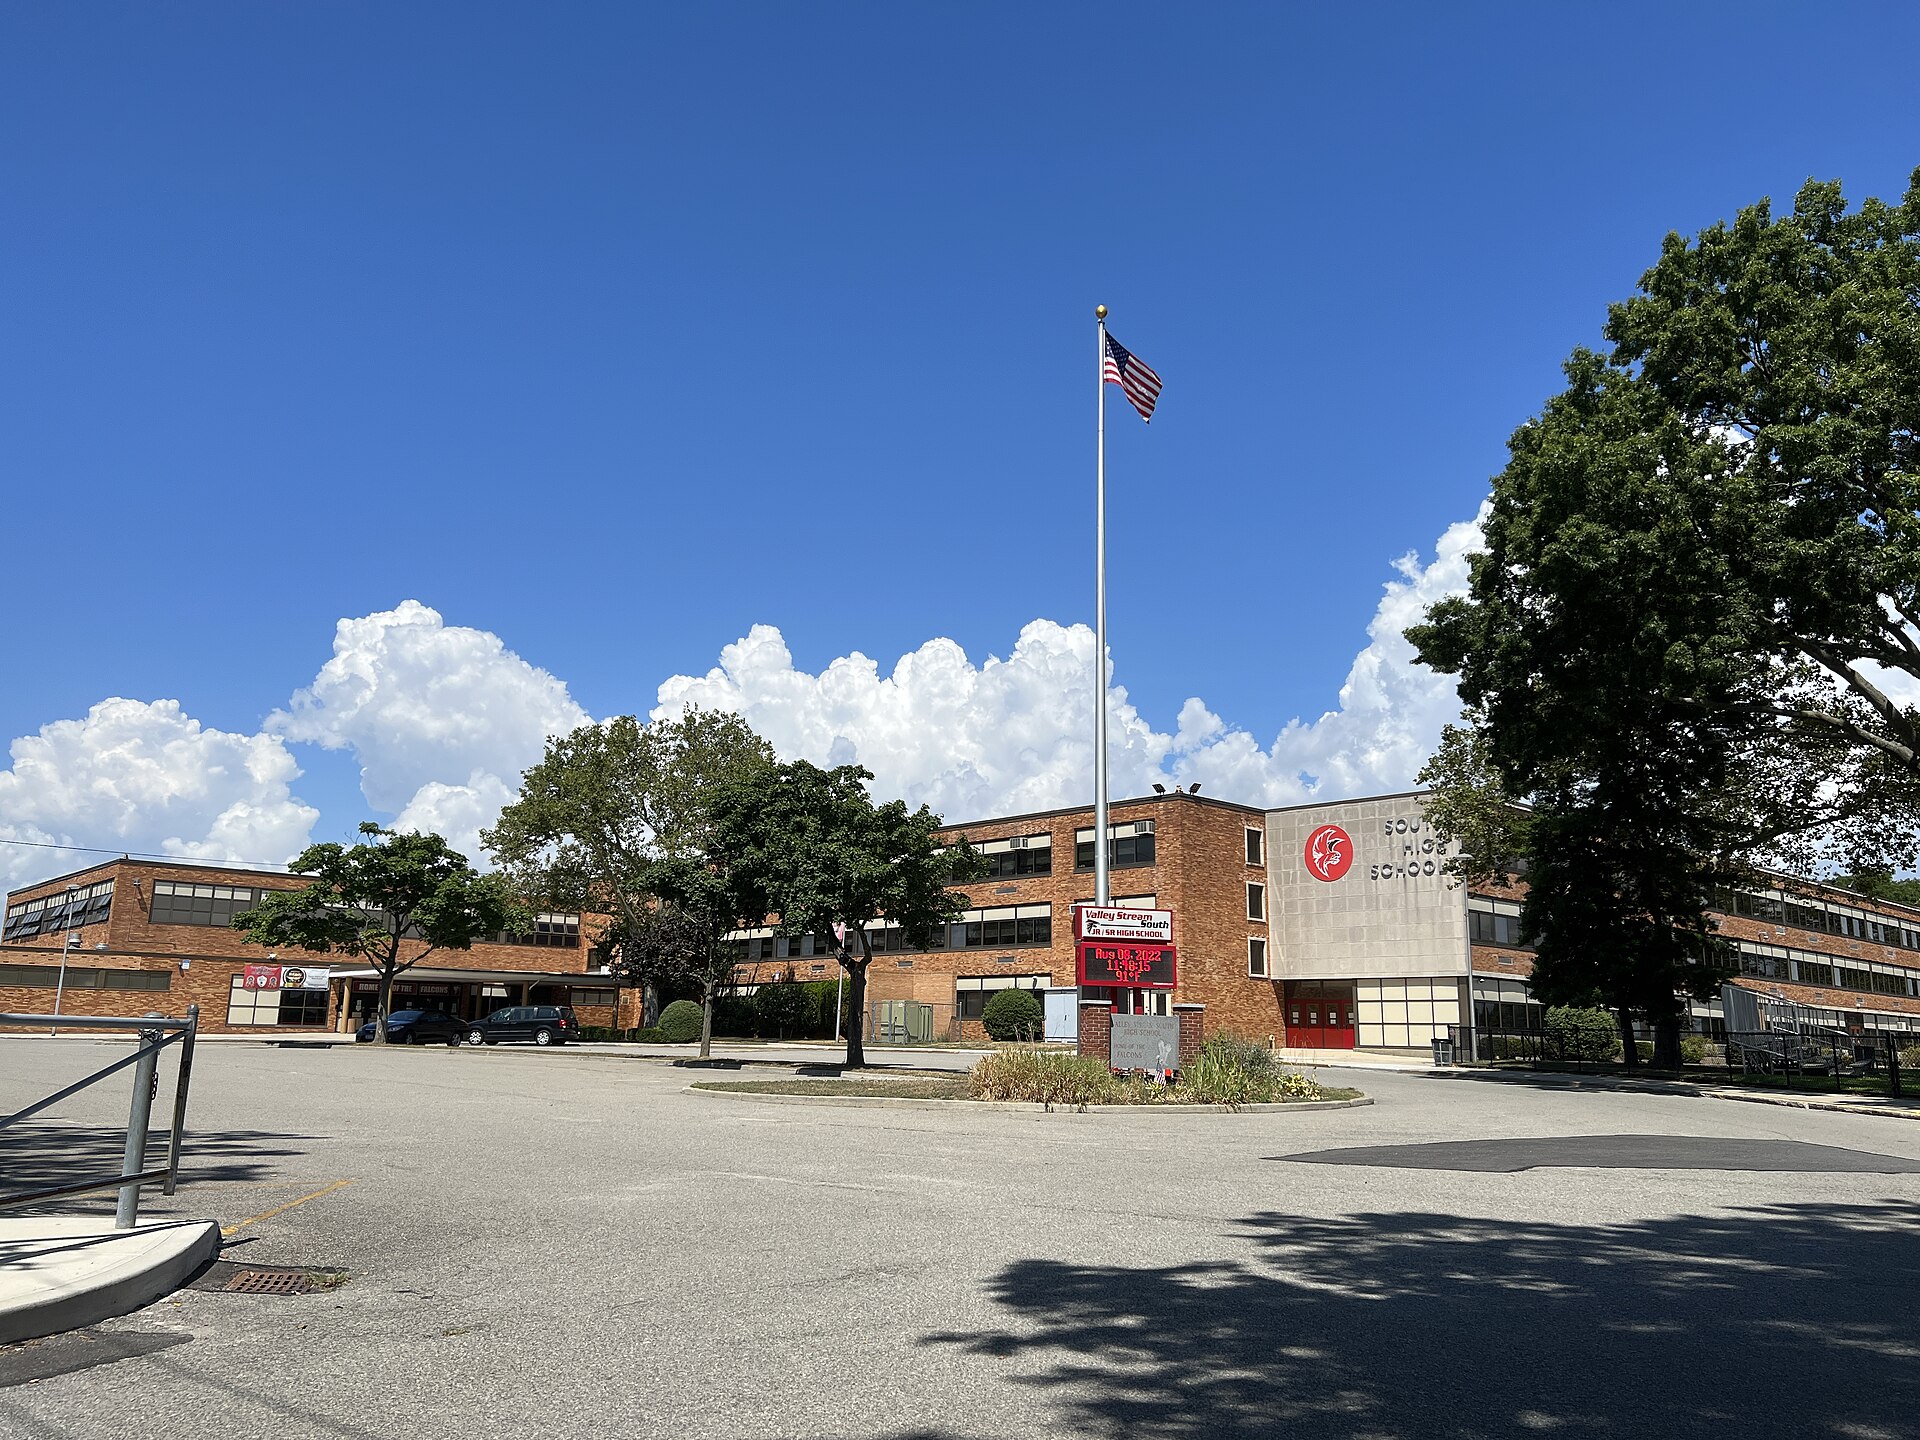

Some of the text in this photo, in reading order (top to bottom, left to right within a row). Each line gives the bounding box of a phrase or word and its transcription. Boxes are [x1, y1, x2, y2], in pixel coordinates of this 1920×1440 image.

[1086, 910, 1153, 921] Valley Stream
[1140, 920, 1169, 929] South
[1135, 930, 1164, 938] SCHOOL
[1095, 948, 1115, 959] Aug
[1135, 949, 1161, 961] 2022
[359, 983, 379, 991] HOME
[401, 985, 413, 993] THE
[420, 986, 448, 994] FALCONS
[1114, 1020, 1131, 1028] ALLEY
[1116, 1050, 1143, 1059] FALCONS
